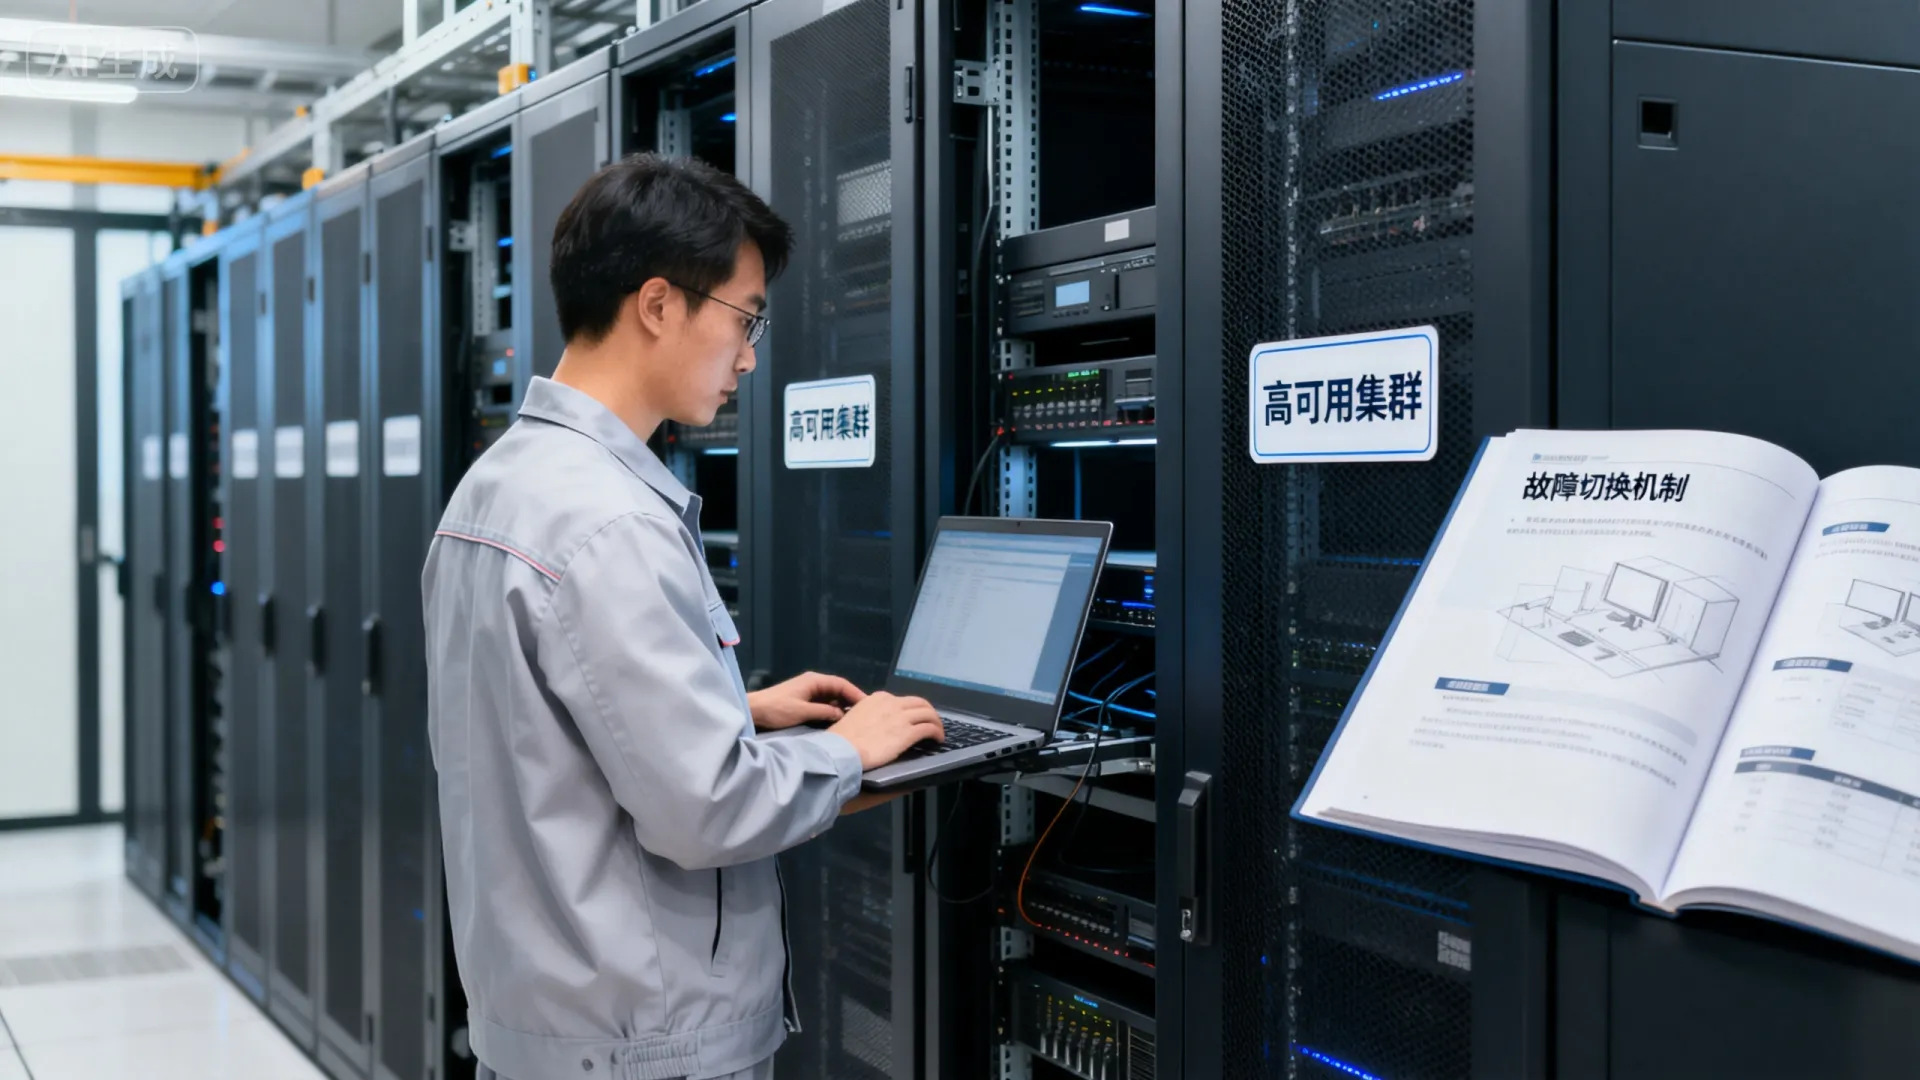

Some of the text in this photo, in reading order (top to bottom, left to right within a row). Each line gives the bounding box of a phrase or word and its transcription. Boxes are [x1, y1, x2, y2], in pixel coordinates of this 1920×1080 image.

[1263, 370, 1422, 426] 高可用集群
[790, 403, 869, 442] 高可用集群
[1522, 471, 1690, 502] 故障切换机制
